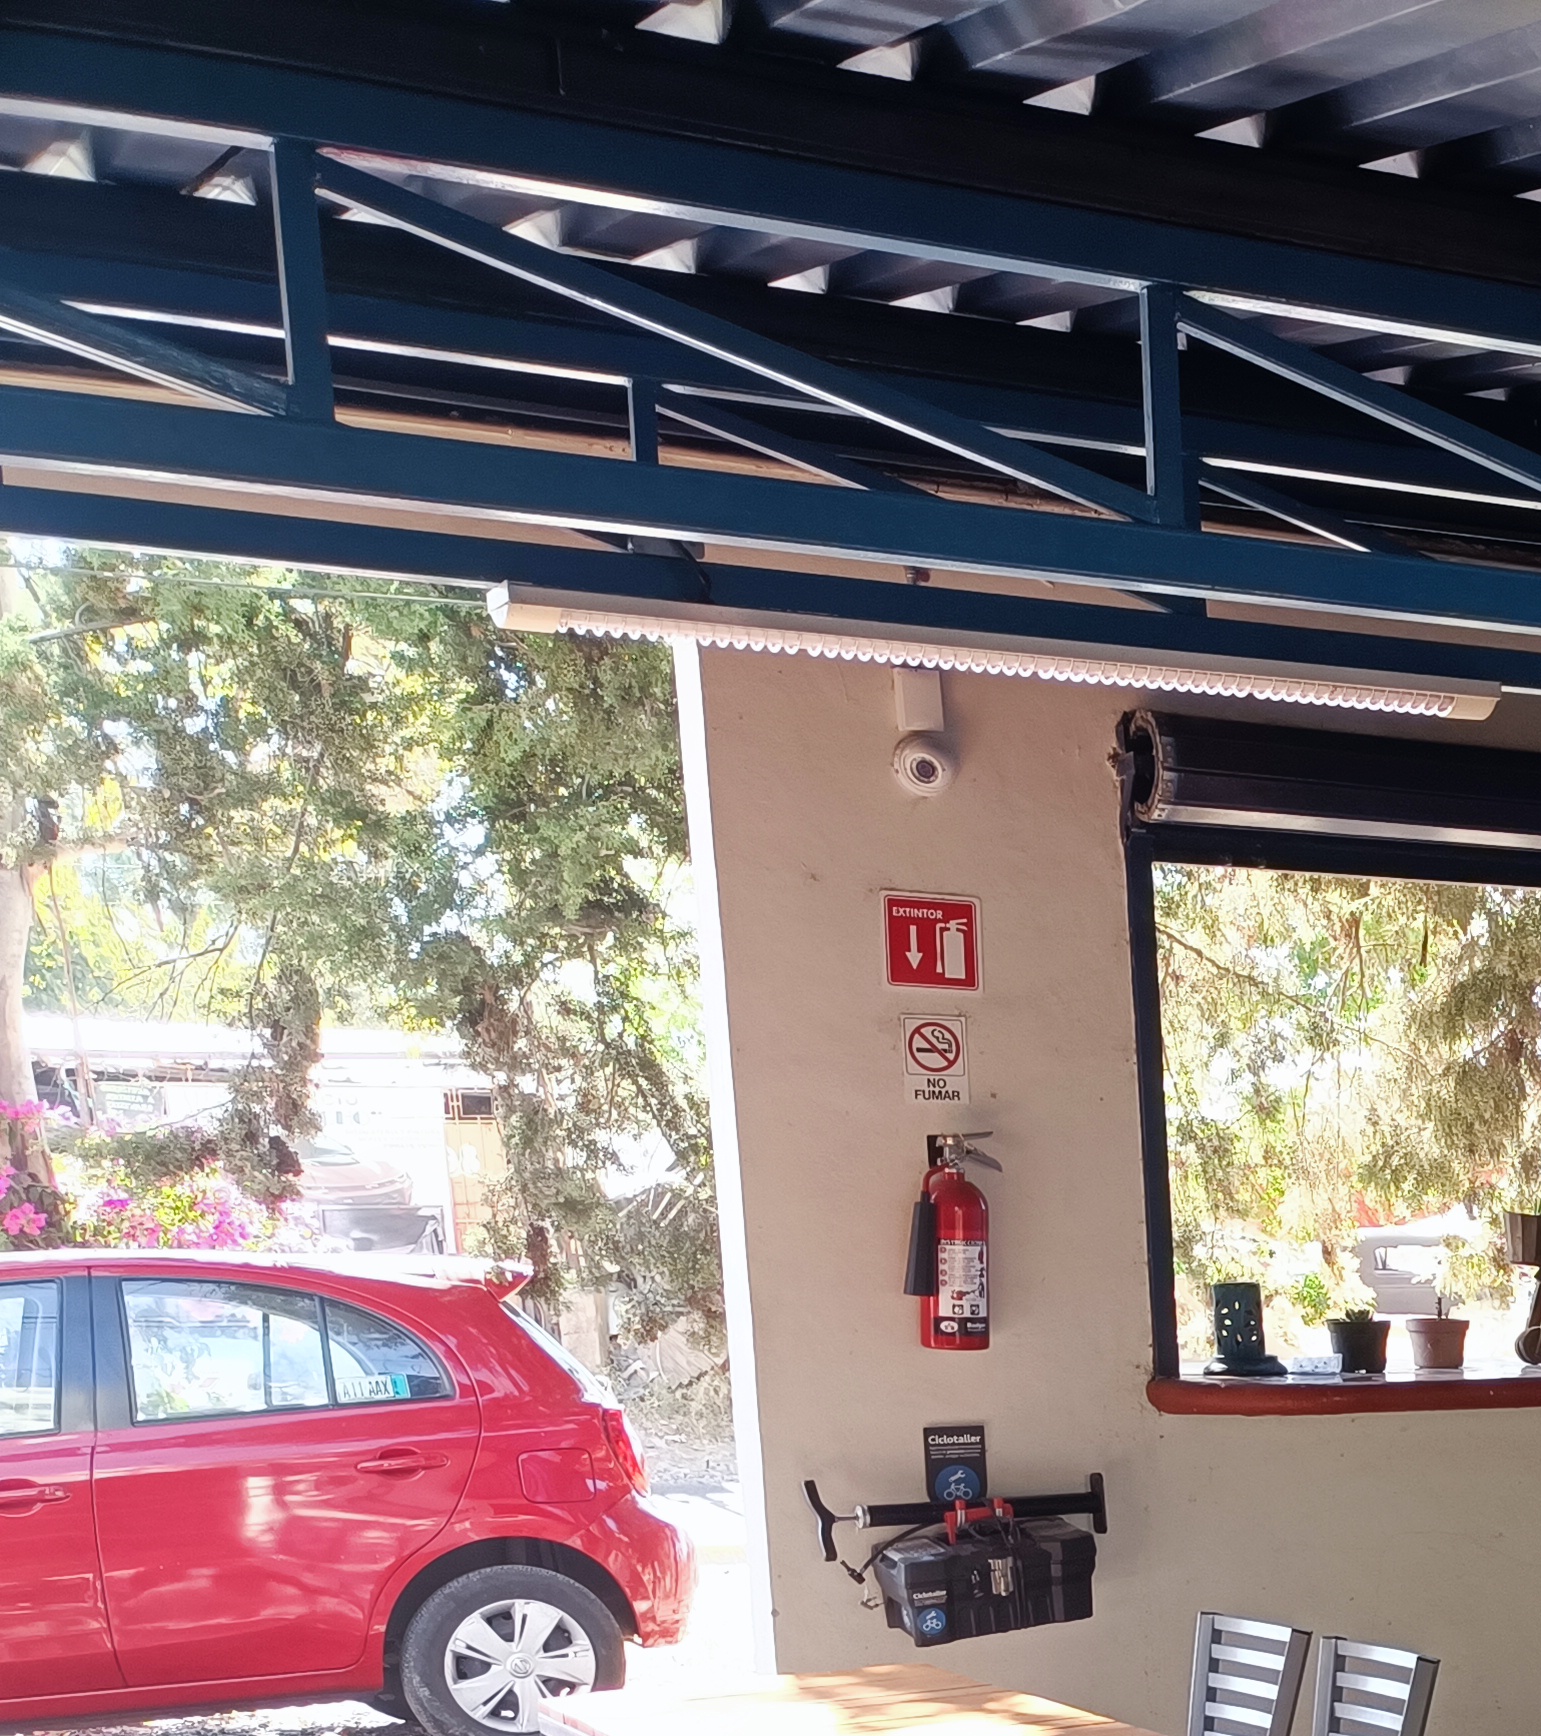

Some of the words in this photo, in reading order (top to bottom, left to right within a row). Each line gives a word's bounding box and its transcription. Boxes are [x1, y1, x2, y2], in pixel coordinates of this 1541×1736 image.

[892, 906, 943, 920] EXTINTOR
[927, 1078, 947, 1089] NO
[914, 1089, 961, 1101] FUMAR
[928, 1434, 981, 1445] Ciclotaller
